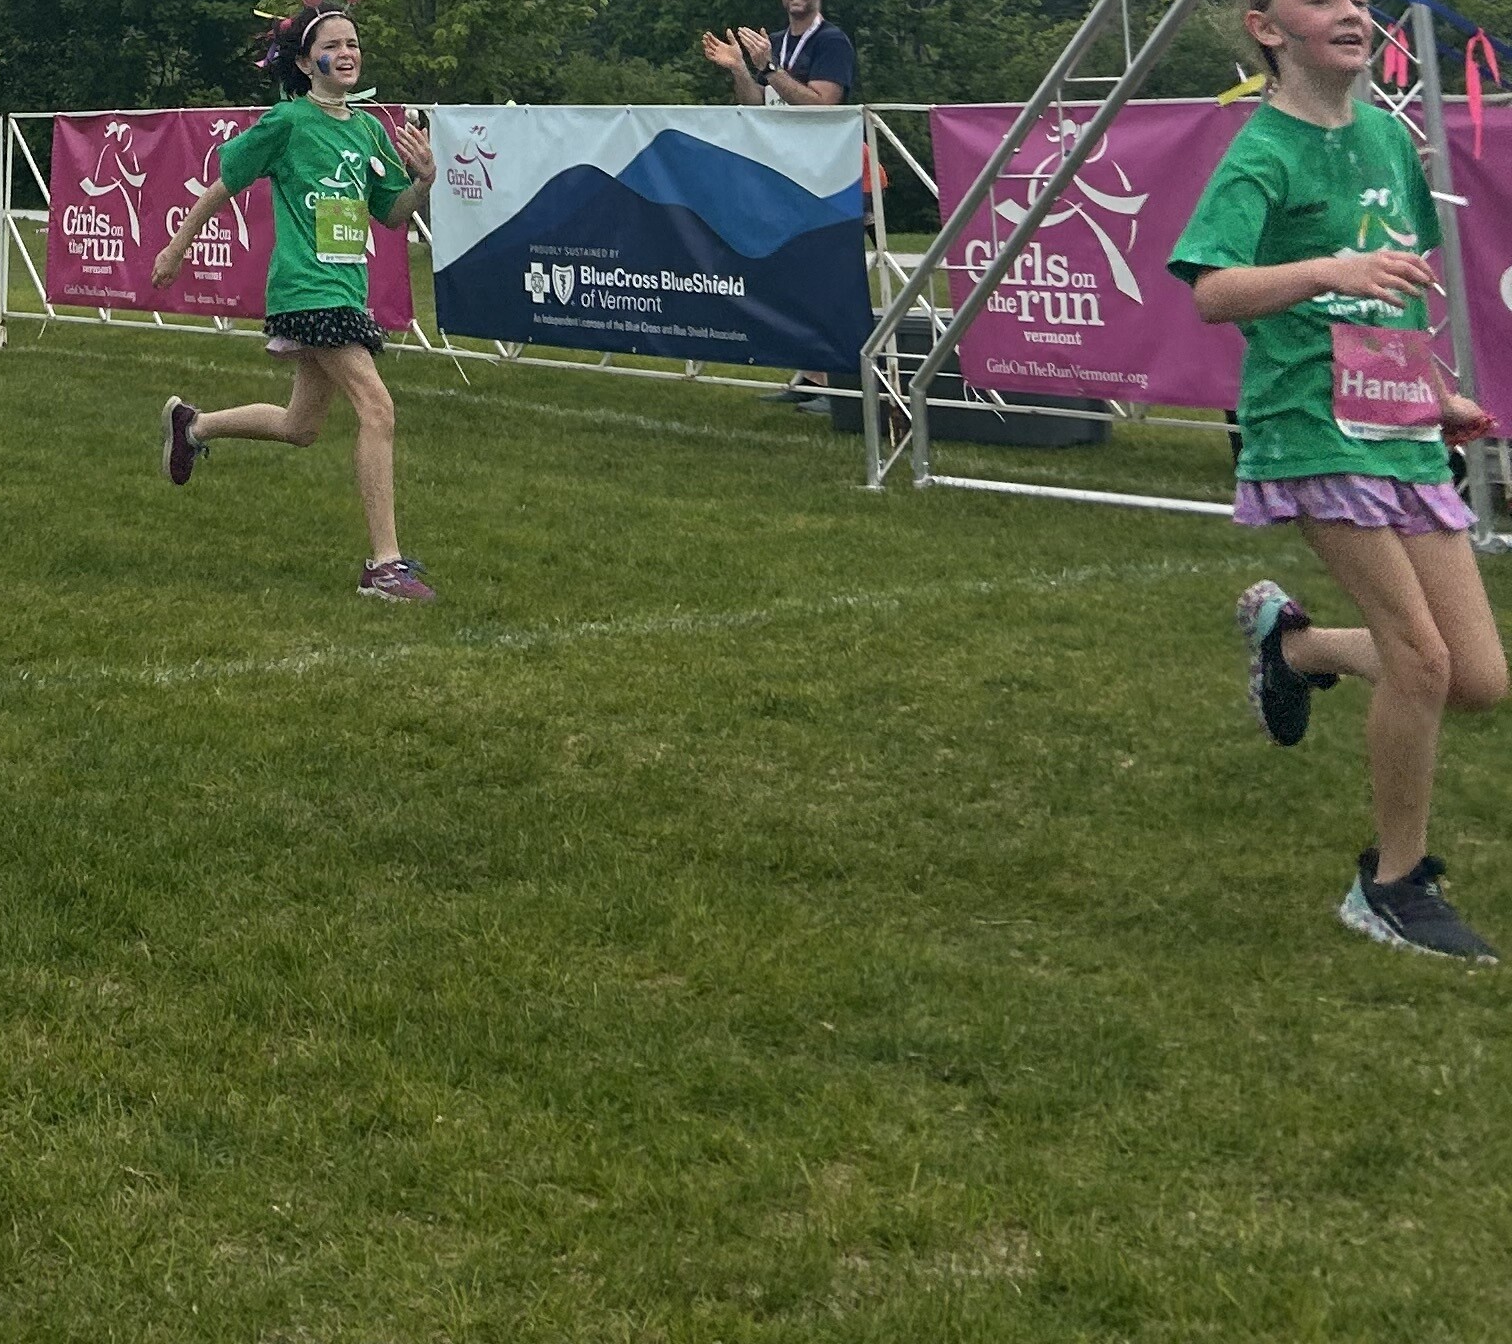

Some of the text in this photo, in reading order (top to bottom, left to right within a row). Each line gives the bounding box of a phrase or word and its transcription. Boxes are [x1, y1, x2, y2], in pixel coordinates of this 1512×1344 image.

[447, 168, 475, 185] Girls
[460, 187, 483, 199] run
[63, 205, 124, 237] Girls on
[333, 224, 365, 241] Eliza
[68, 238, 125, 261] the run
[191, 242, 233, 267] run
[580, 265, 745, 297] BlueCross BlueShield
[1071, 273, 1097, 288] on
[581, 288, 663, 313] of Vermont
[1016, 290, 1105, 326] run
[1023, 330, 1082, 345] vermont
[987, 357, 1148, 389] GirlsOnTheRunVermont.org
[1341, 369, 1437, 405] Hannah
